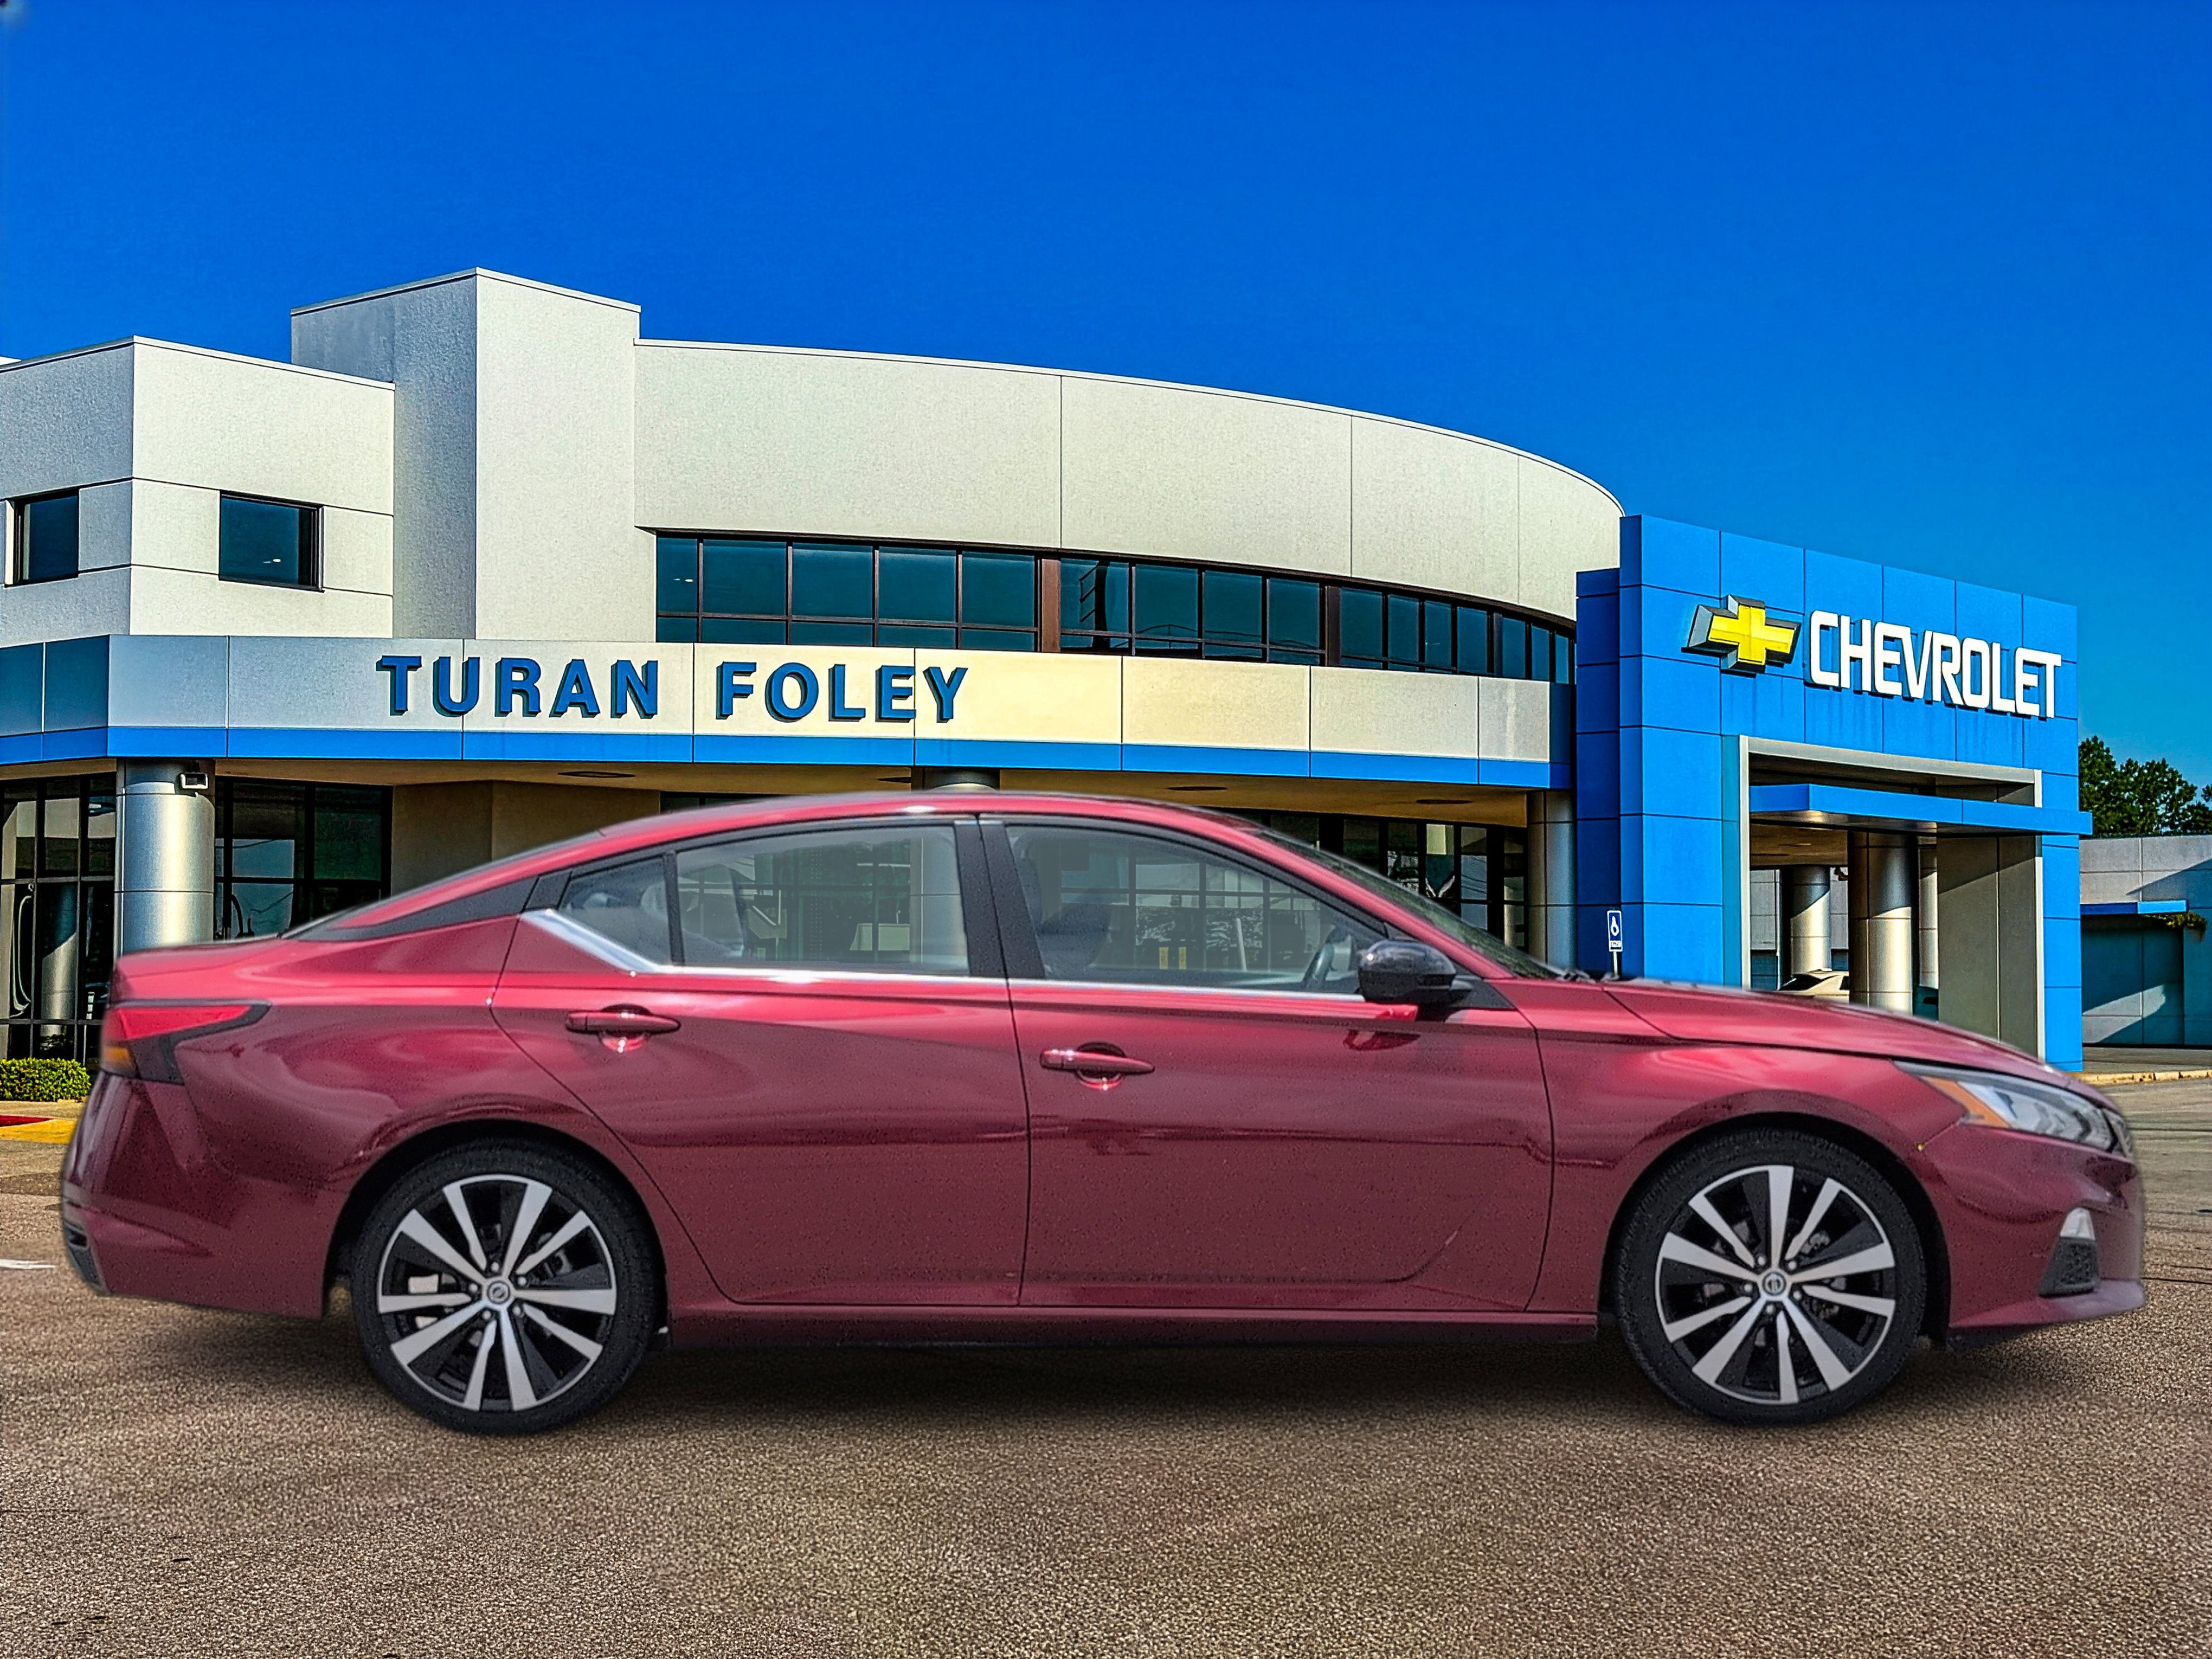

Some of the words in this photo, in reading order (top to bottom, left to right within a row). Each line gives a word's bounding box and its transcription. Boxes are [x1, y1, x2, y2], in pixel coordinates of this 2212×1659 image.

[377, 655, 658, 719] TURAN
[716, 661, 969, 723] FOLEY
[1810, 610, 2062, 718] CHEVROLET
